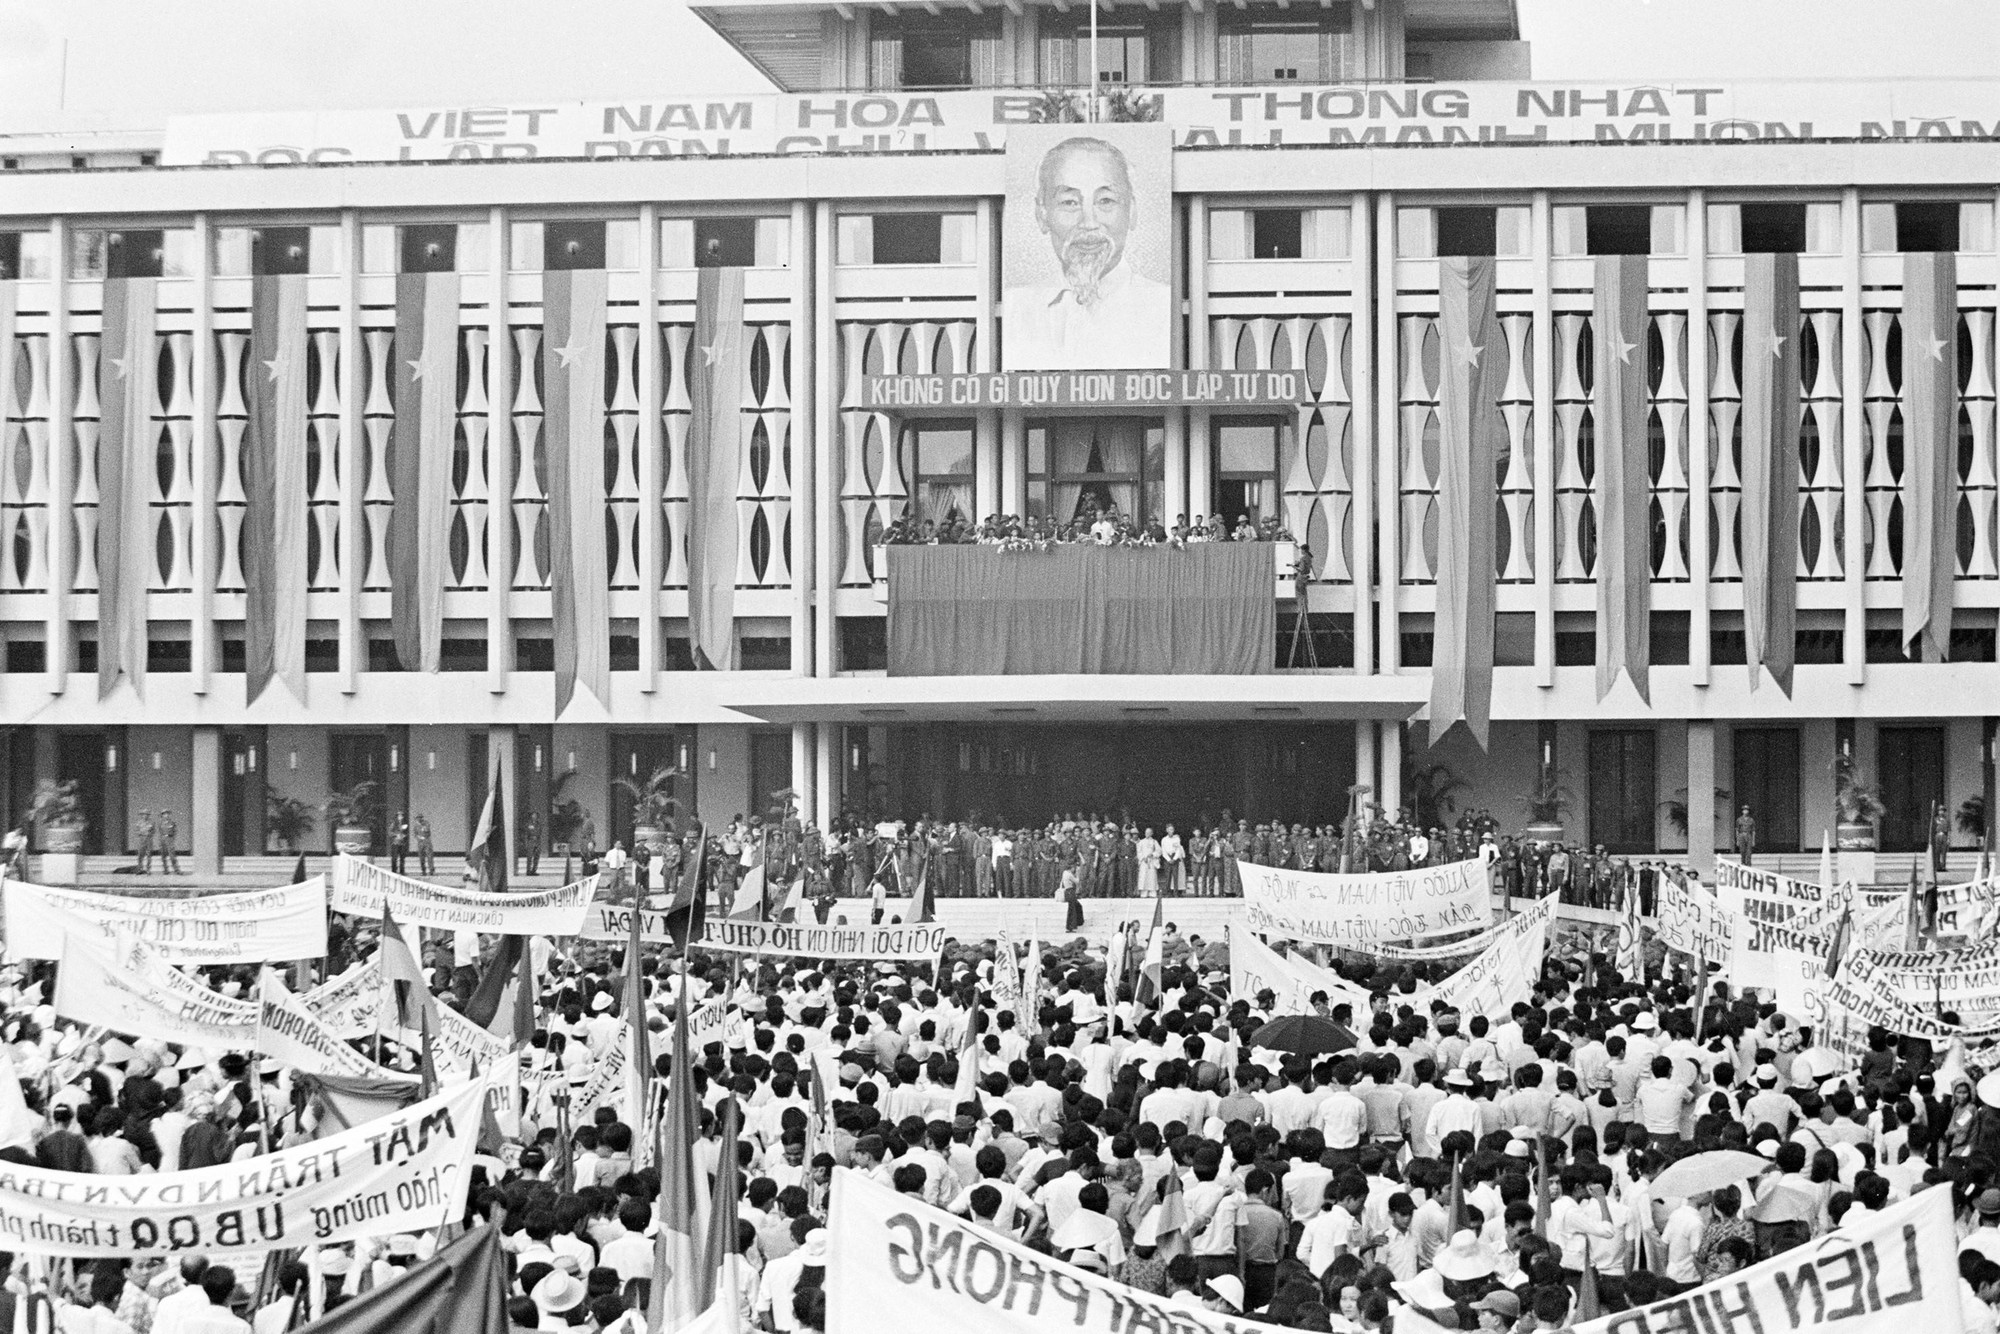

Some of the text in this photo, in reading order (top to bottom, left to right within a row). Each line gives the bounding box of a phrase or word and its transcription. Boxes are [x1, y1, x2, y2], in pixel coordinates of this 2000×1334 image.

[602, 102, 753, 134] NAM
[871, 374, 944, 405] KHÔNG
[950, 371, 978, 404] CÓ
[988, 372, 1011, 405] GÌ
[1018, 372, 1060, 406] QUÝ
[1125, 371, 1172, 404] ĐỘC
[1267, 373, 1296, 400] DO
